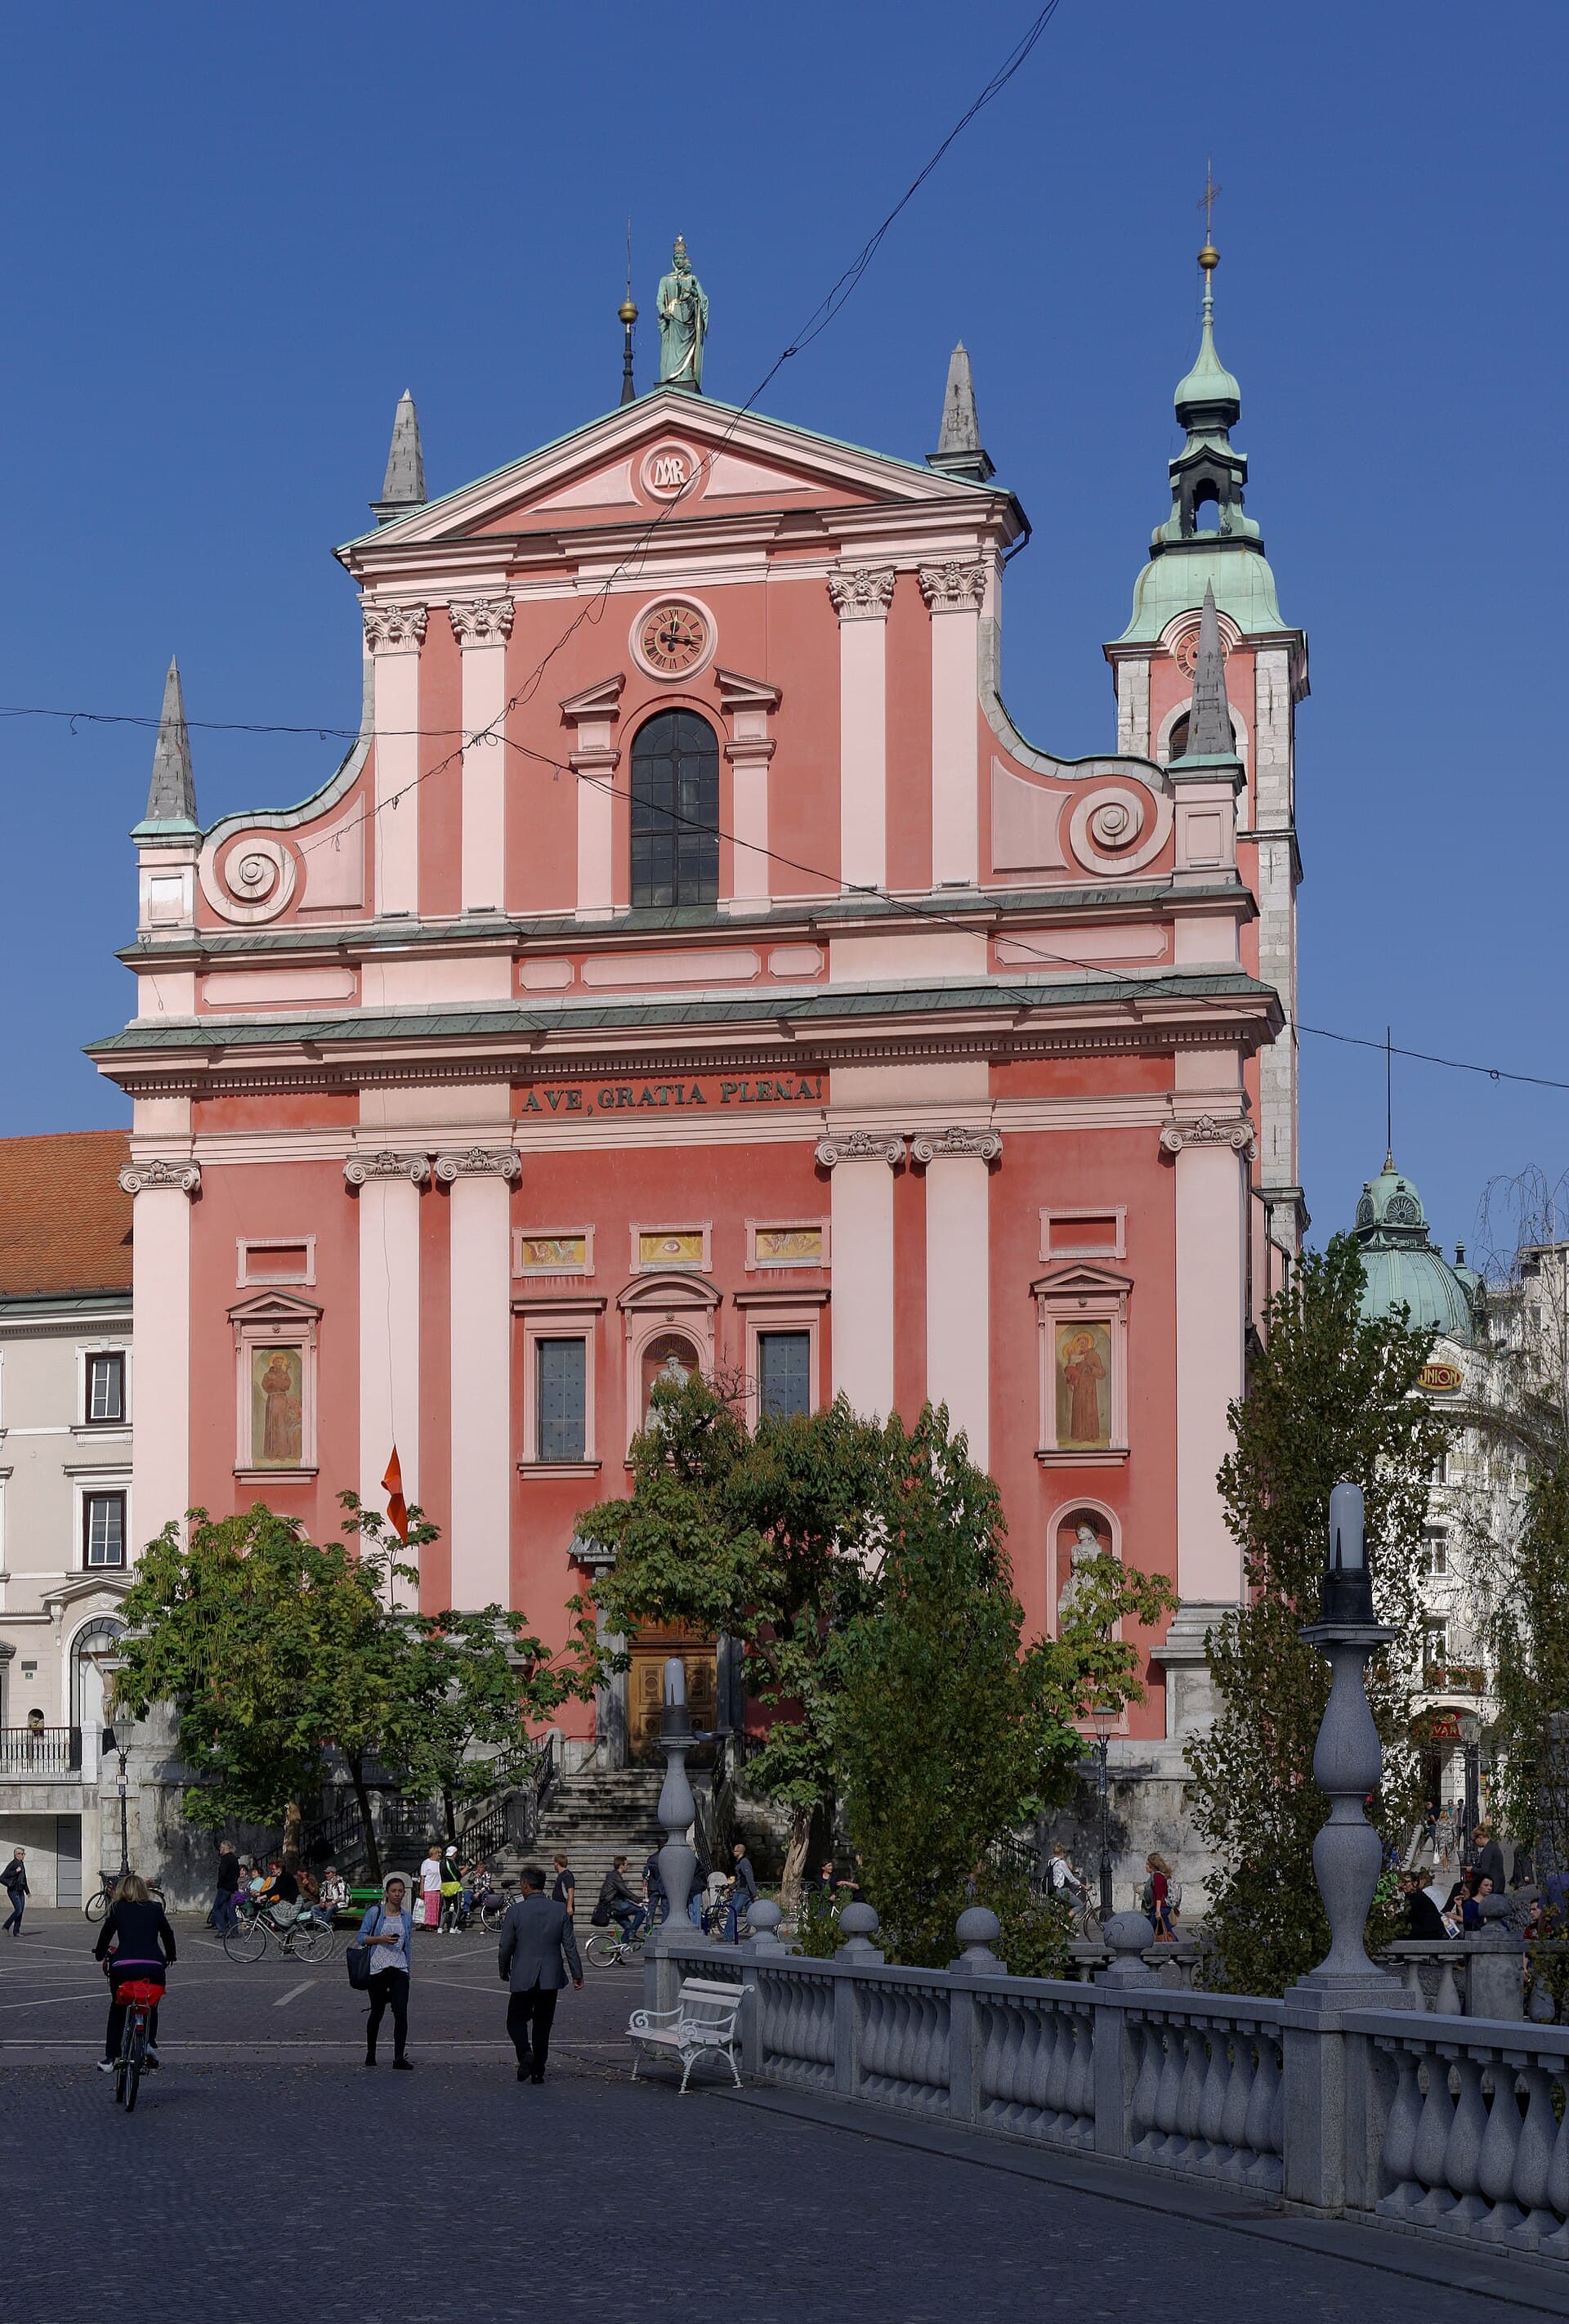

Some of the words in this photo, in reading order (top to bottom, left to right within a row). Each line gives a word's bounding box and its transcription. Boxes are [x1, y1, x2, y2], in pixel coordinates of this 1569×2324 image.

[597, 1084, 707, 1108] GRATIA
[720, 1077, 823, 1104] PLENA!
[1419, 1369, 1457, 1385] UNION
